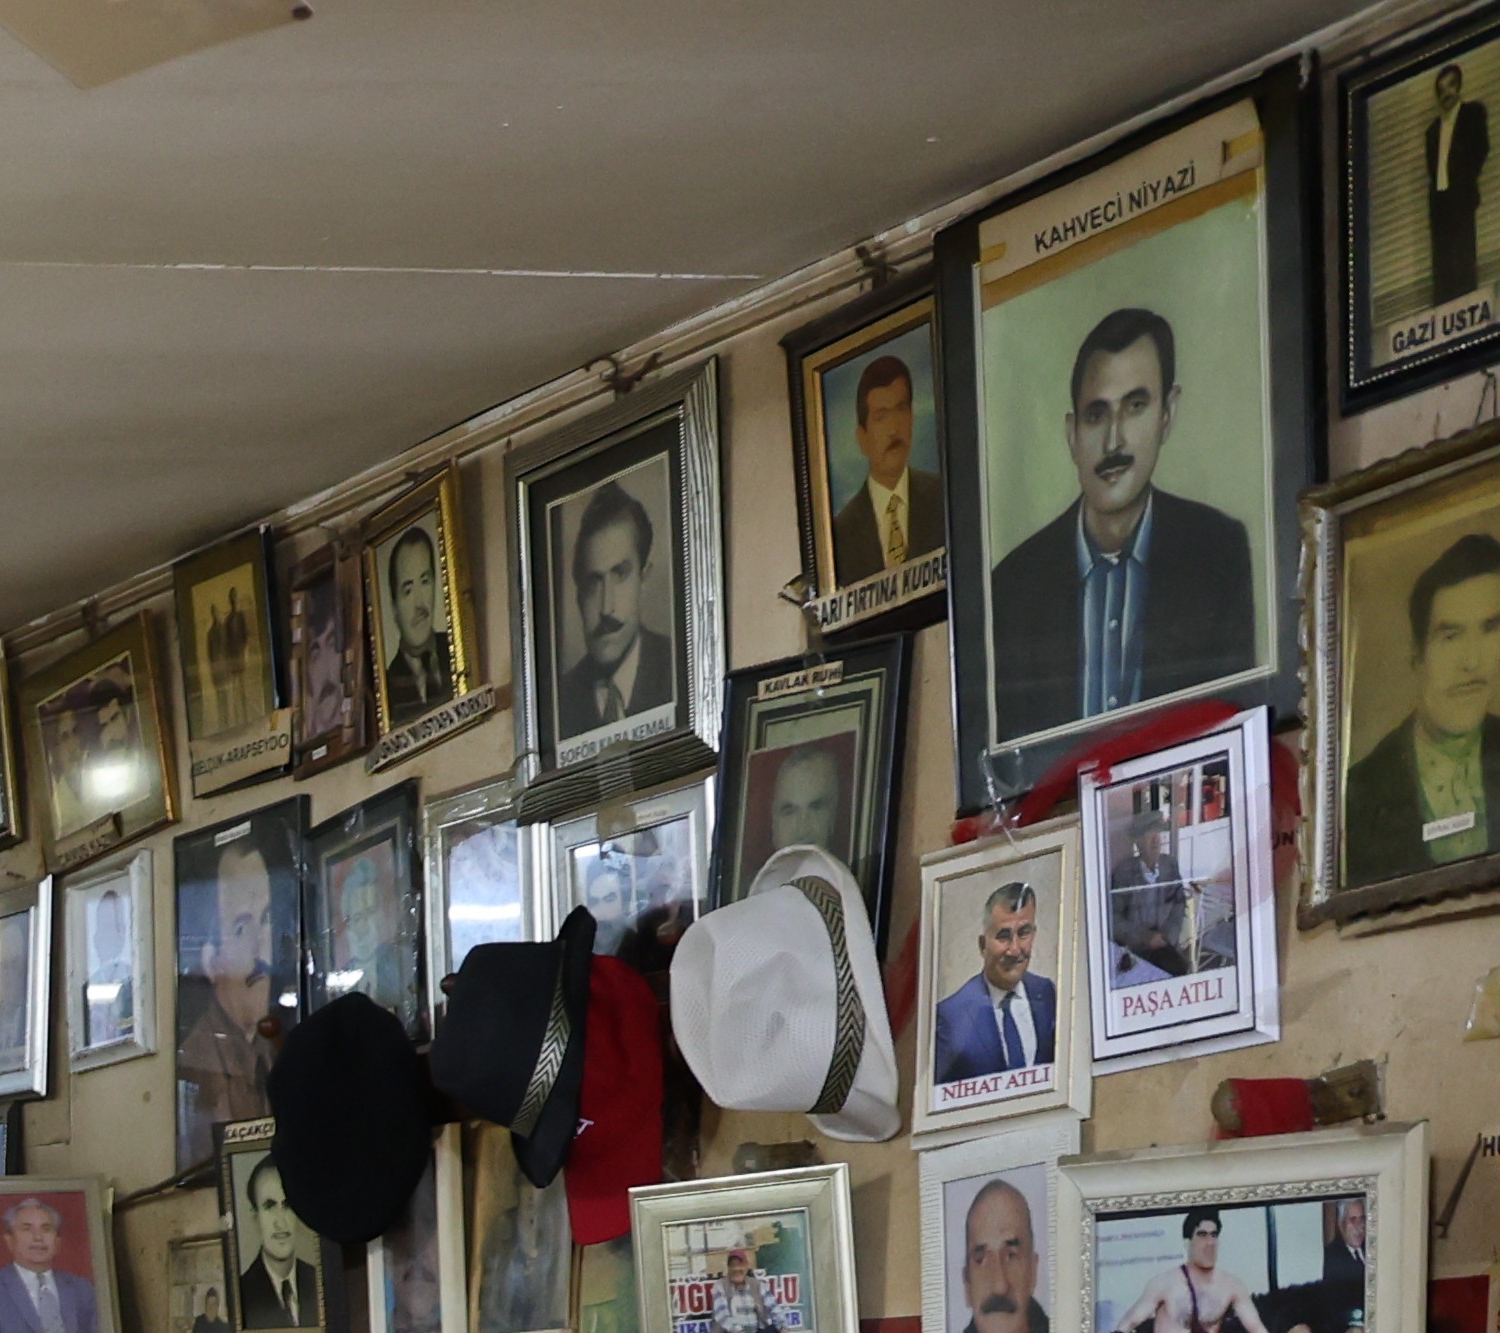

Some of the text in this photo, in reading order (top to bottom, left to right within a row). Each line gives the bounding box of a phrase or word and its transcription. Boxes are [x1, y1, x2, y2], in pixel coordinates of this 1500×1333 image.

[1033, 163, 1196, 252] KAHVECİ NİYAZİ
[1392, 301, 1491, 352] GAZİ USTA
[847, 573, 899, 612] FIRTINA
[903, 552, 948, 593] KUDRE
[631, 716, 673, 741] KEMAL
[1123, 976, 1224, 1017] PAŞA ATLI
[942, 1065, 1050, 1101] NİHAT ATLI
